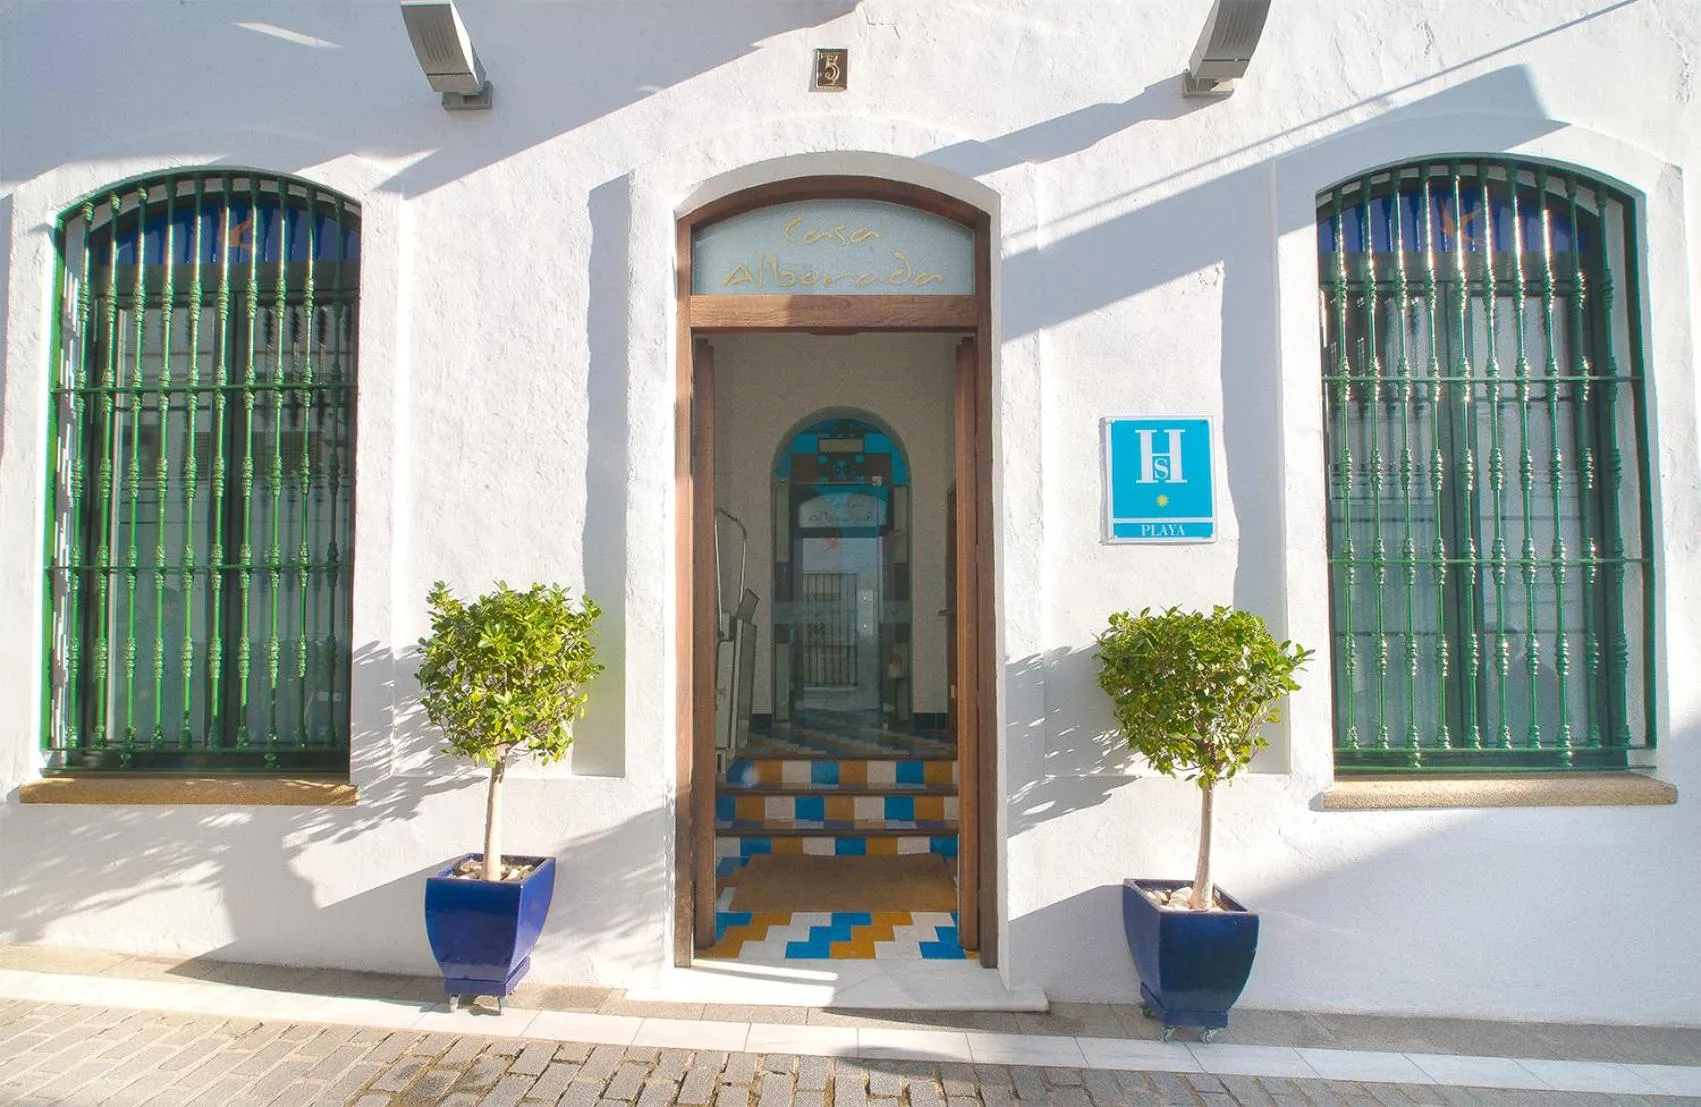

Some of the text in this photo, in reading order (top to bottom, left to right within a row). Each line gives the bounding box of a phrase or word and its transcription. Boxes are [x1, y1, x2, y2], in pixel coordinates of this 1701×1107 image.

[783, 213, 881, 247] Casa
[720, 250, 944, 288] Alborada
[1141, 524, 1185, 536] PLAYA
